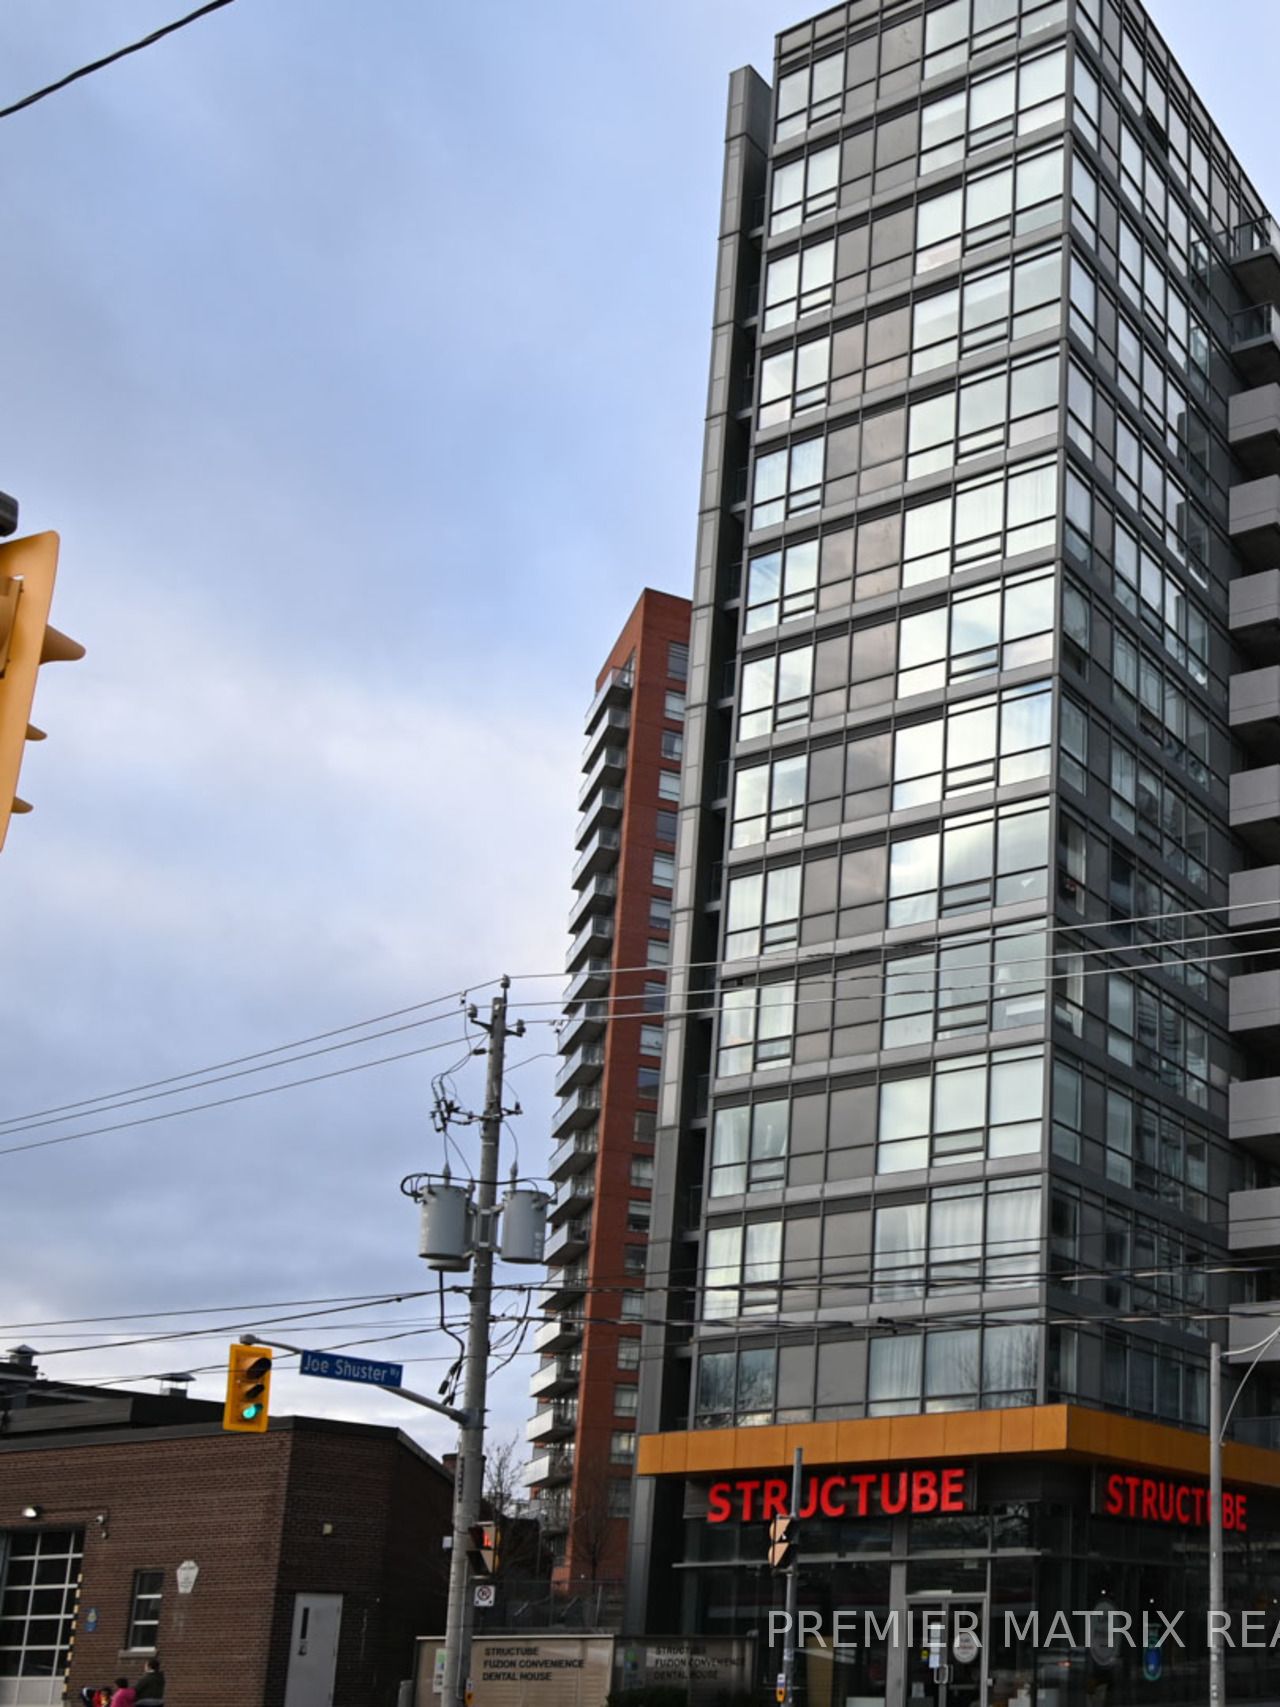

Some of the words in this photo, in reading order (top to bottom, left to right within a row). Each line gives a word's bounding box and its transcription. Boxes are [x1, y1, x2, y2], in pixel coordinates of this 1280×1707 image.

[304, 1354, 329, 1374] Joe
[335, 1359, 388, 1382] Shuster
[485, 1646, 539, 1657] STRUCTUBE
[483, 1659, 516, 1669] FUZION
[518, 1659, 585, 1669] CONVENIENCE
[482, 1672, 517, 1681] DENTAL
[519, 1671, 553, 1681] HOUSE
